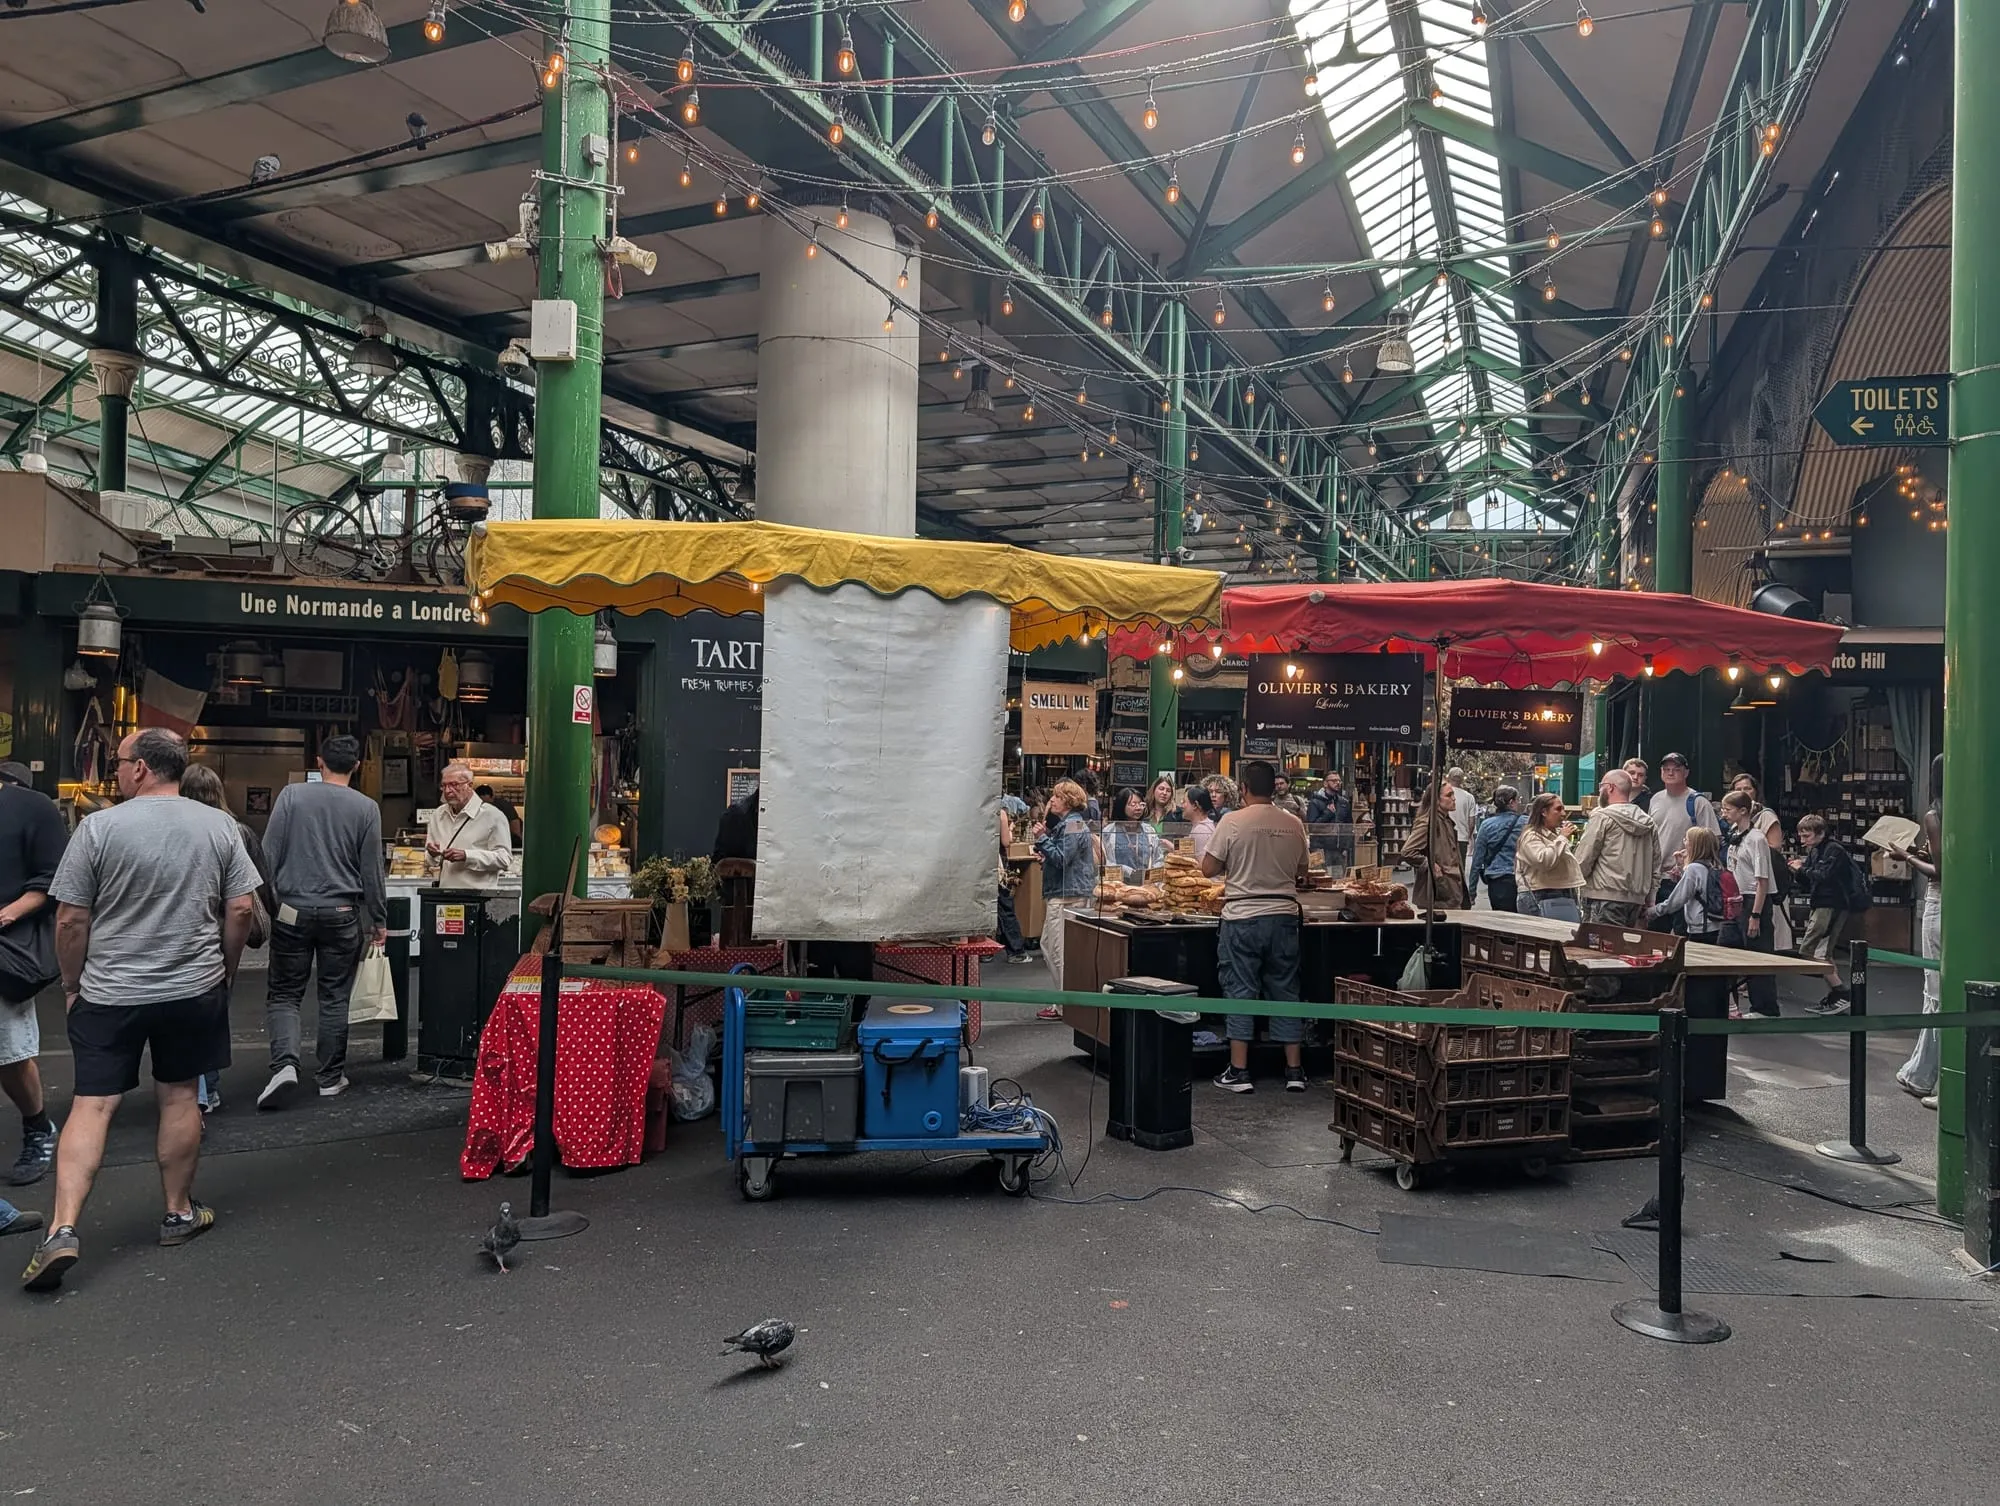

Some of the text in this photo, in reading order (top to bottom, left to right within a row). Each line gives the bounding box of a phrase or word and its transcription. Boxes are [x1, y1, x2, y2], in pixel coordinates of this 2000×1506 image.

[1850, 387, 1938, 411] TOILETS
[241, 592, 277, 614] Une
[286, 594, 384, 619] Normande
[392, 603, 402, 619] a
[691, 639, 762, 669] TART
[1861, 652, 1886, 669] Hill
[682, 677, 711, 691] FRESH
[714, 679, 754, 692] TRUFFLES
[1258, 682, 1412, 696] OLIVIER'S BAKERY
[1030, 693, 1090, 711] SMELL ME
[1315, 697, 1350, 710] London
[1458, 708, 1519, 720] OLIVIER'S
